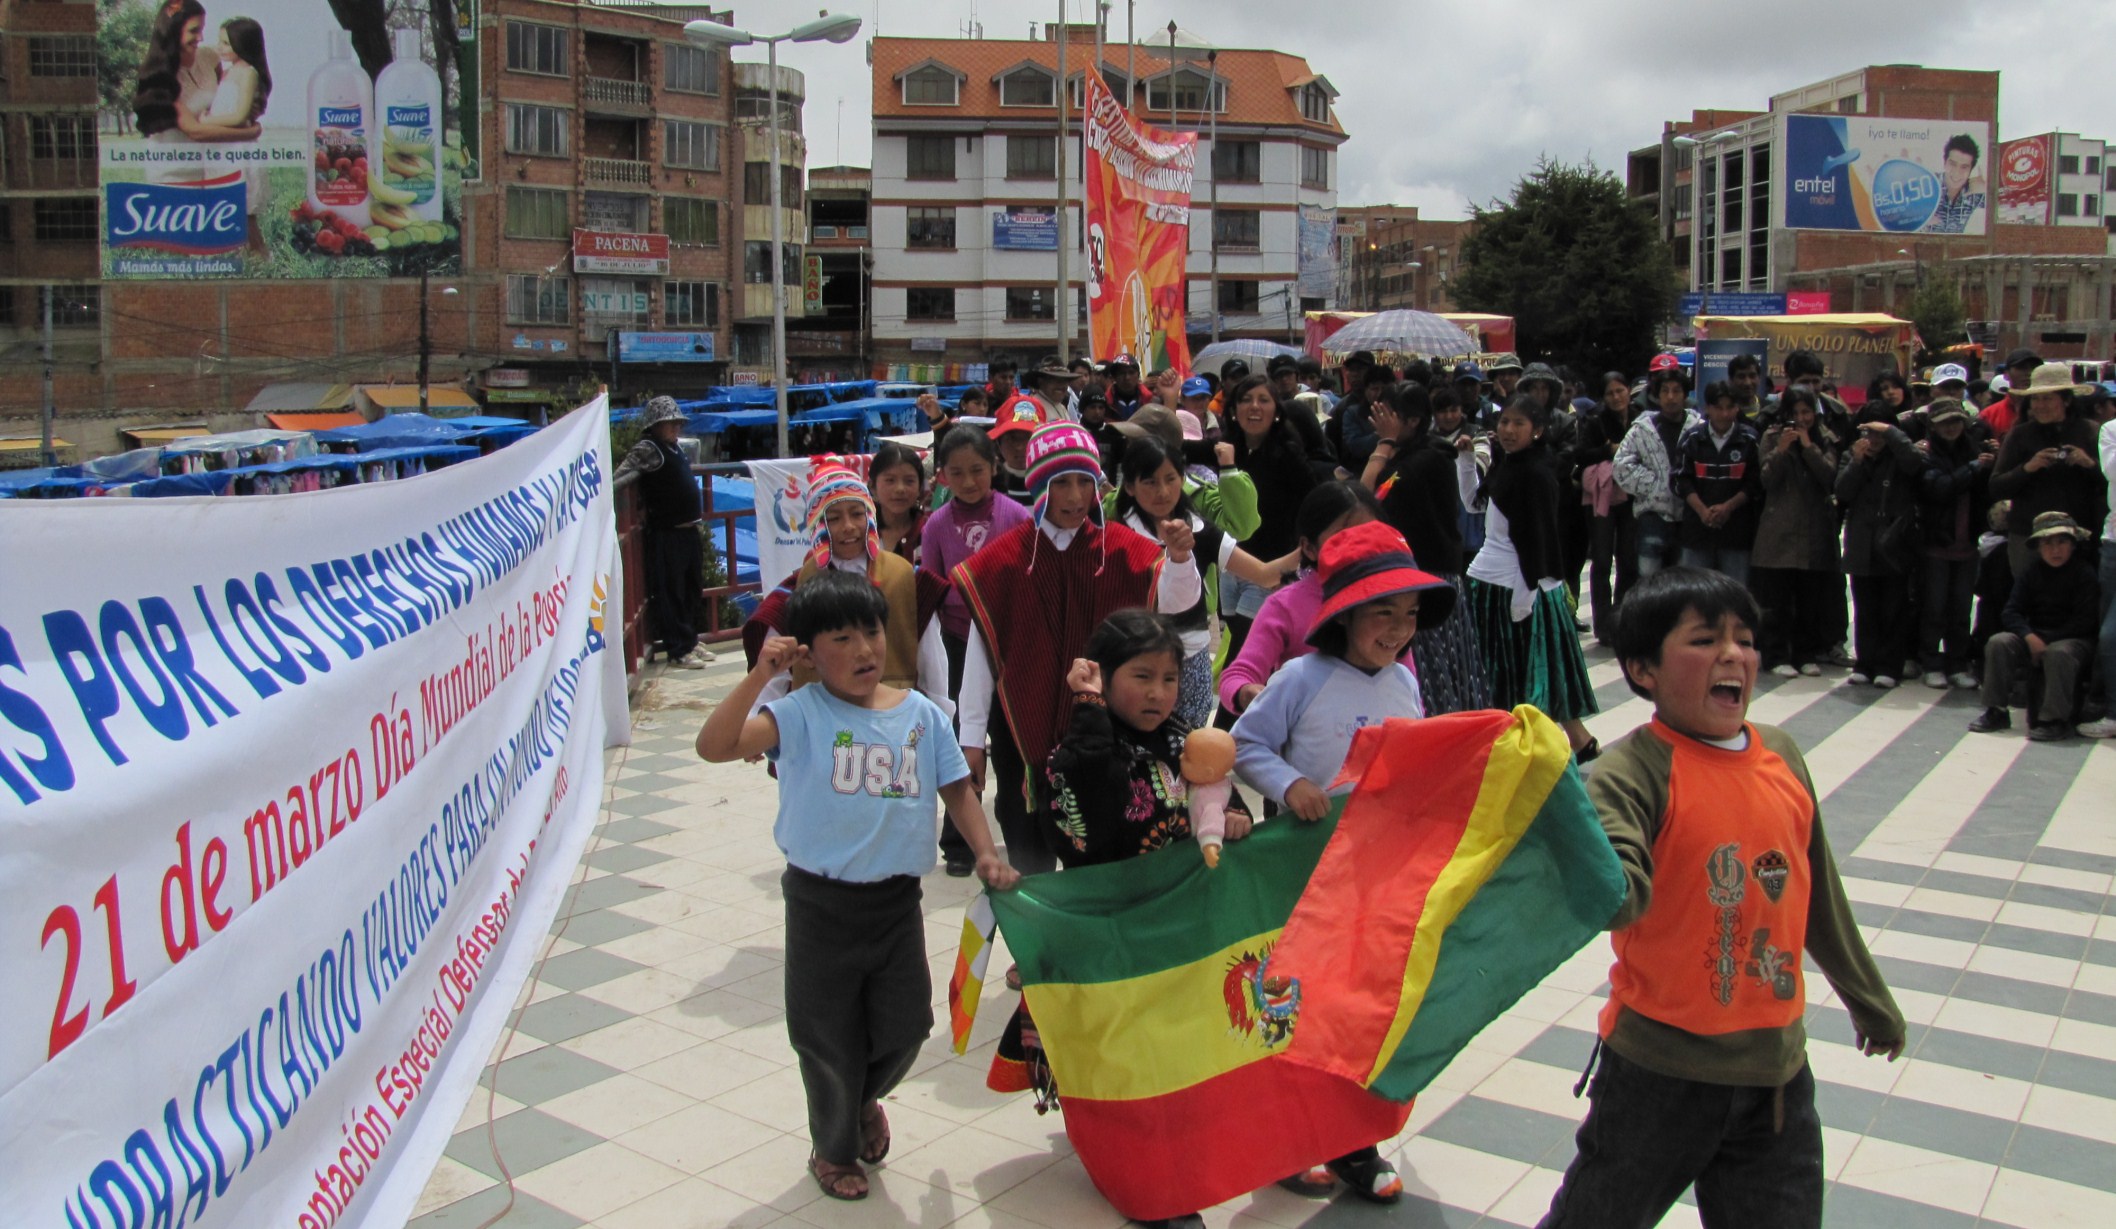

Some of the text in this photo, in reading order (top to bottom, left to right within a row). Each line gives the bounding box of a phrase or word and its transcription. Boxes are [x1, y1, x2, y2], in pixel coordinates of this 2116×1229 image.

[321, 107, 359, 124] Suave
[389, 106, 427, 123] Suave
[1887, 128, 1897, 139] te
[1900, 128, 1930, 141] llamo!
[111, 148, 306, 163] La naturaleza te queda bien.
[2007, 145, 2039, 164] PINTURAS
[1794, 175, 1835, 193] entel
[2006, 168, 2040, 182] MONOPOL
[1809, 194, 1835, 206] móvil
[114, 193, 237, 236] Suave
[119, 259, 237, 273] Mamás más lindas.
[1776, 334, 1799, 351] UN
[1804, 334, 1844, 352] SOLO
[42, 596, 241, 767] POR
[193, 571, 331, 700] LOS
[285, 531, 473, 660] DERECHOS
[438, 486, 546, 590] HUMANOS
[531, 478, 554, 540] Y
[547, 468, 568, 533] LA
[831, 741, 920, 798] USA
[41, 872, 137, 1062] 21
[160, 819, 233, 965] de
[244, 747, 364, 905] marzo
[370, 690, 416, 801] Día
[499, 611, 516, 682] de
[516, 601, 532, 663] la
[363, 822, 448, 1006] VALORES
[442, 772, 489, 887] PARA
[1767, 879, 1782, 891] 43
[438, 891, 511, 1015] Defensor
